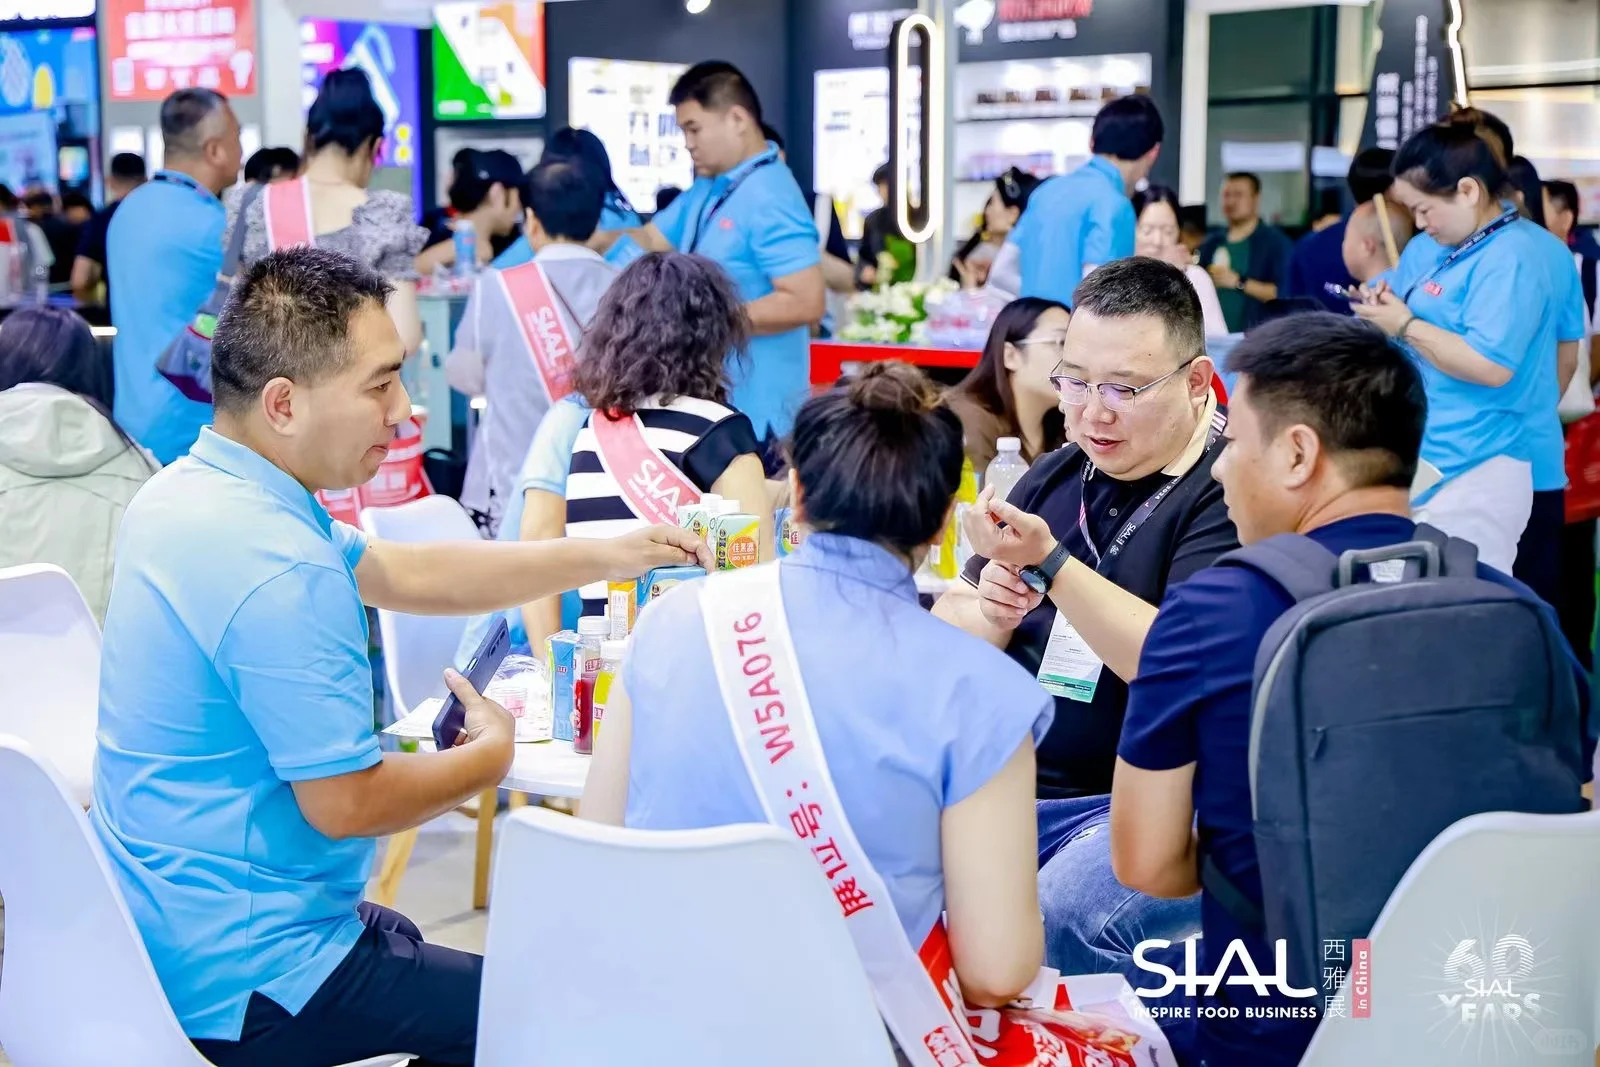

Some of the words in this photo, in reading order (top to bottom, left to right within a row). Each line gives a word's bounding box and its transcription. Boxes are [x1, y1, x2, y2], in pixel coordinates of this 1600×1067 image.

[531, 306, 568, 369] SIAL
[632, 458, 694, 517] SIA
[733, 611, 795, 765] W5A076
